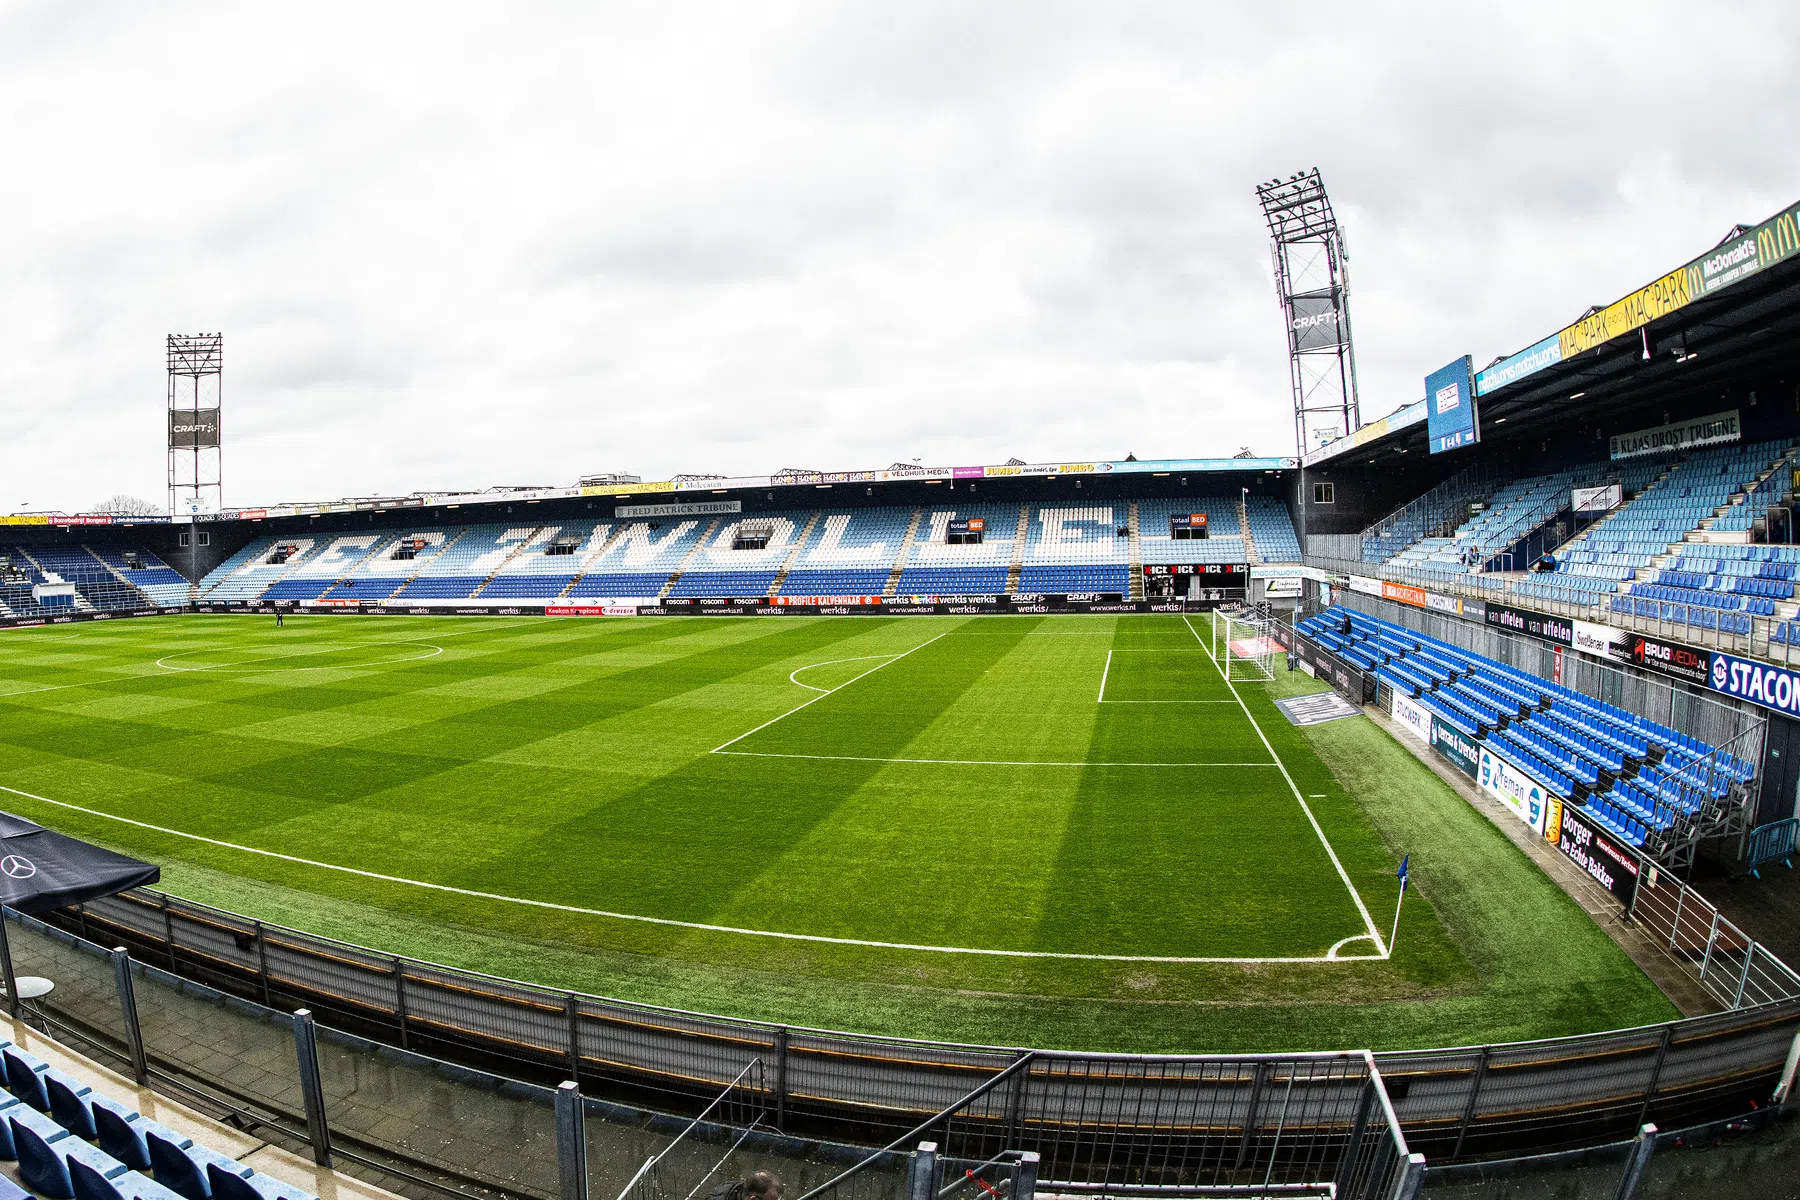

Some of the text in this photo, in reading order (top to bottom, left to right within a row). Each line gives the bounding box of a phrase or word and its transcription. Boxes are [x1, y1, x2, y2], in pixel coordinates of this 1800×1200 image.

[1703, 239, 1756, 278] McDonald's
[1293, 312, 1333, 329] CRAFT
[1621, 417, 1737, 453] KLAAS DROST TRIBUNE
[986, 467, 1021, 476] JUMBO
[1059, 464, 1094, 473] JUMBO
[771, 475, 796, 484] HANOS
[797, 474, 822, 482] HANOS
[849, 472, 874, 480] HANOS
[685, 481, 721, 489] Molecaten
[627, 503, 738, 515] FRED PATRICK TRIBUNE
[53, 516, 106, 524] Bouwbedrijf Bongers
[1251, 568, 1303, 578] matchworks
[788, 596, 861, 605] PROFILE KALVENHAAR
[881, 595, 996, 604] werkis werkis werkis werkis
[1488, 611, 1571, 641] van uffelen van uffelen
[1645, 642, 1707, 670] BRUGMEDIA.NL
[1459, 738, 1478, 765] trends
[1562, 808, 1593, 847] Borger
[1561, 834, 1614, 890] De Echte Bakker
